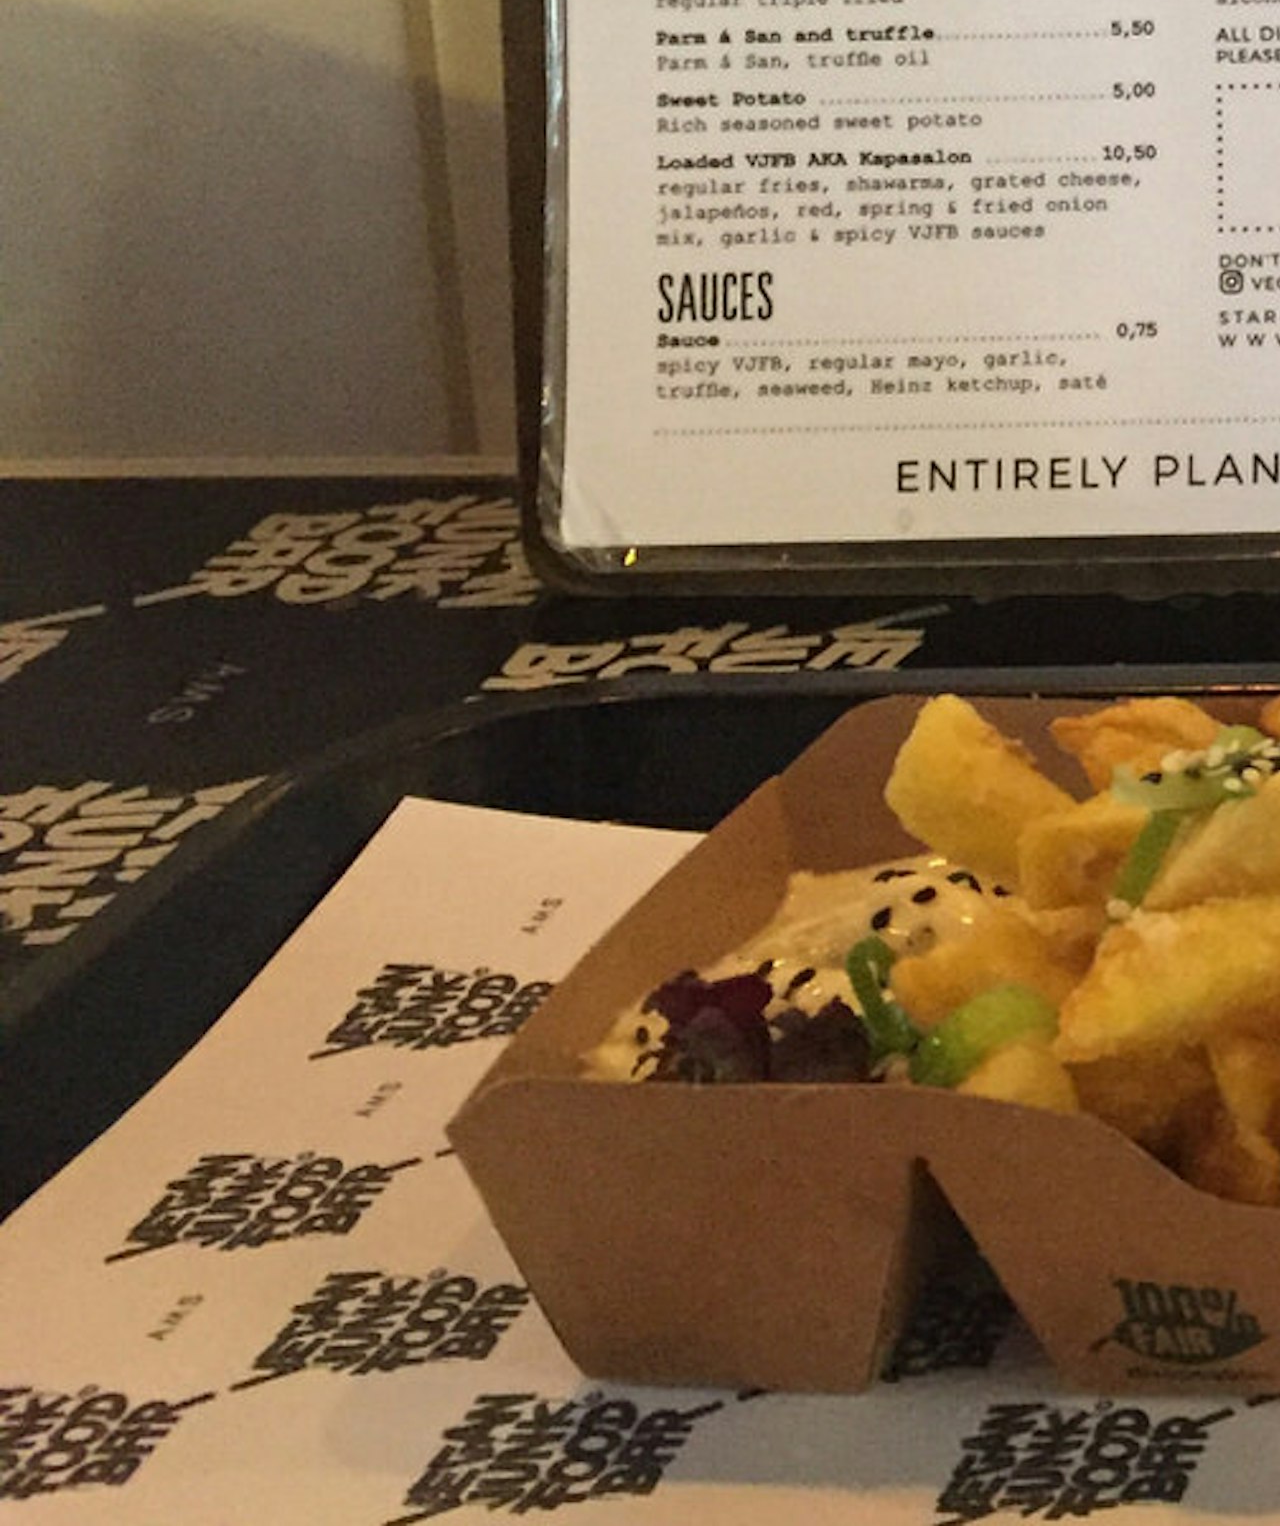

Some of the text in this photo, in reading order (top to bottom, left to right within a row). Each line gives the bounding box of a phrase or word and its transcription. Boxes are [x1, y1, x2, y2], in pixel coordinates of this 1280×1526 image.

[744, 28, 783, 43] San
[793, 25, 834, 42] and
[845, 24, 936, 40] truffle
[1111, 20, 1155, 39] 5,50
[1216, 26, 1251, 42] ALL
[656, 82, 1155, 107] Sweet Potato 5,00
[656, 152, 735, 169] Loaded
[806, 151, 849, 166] AKA
[1102, 144, 1157, 163] 10,50
[658, 270, 774, 324] SAUCES
[656, 321, 1158, 348] Sauce 0,75
[896, 456, 1128, 493] ENTIRELY
